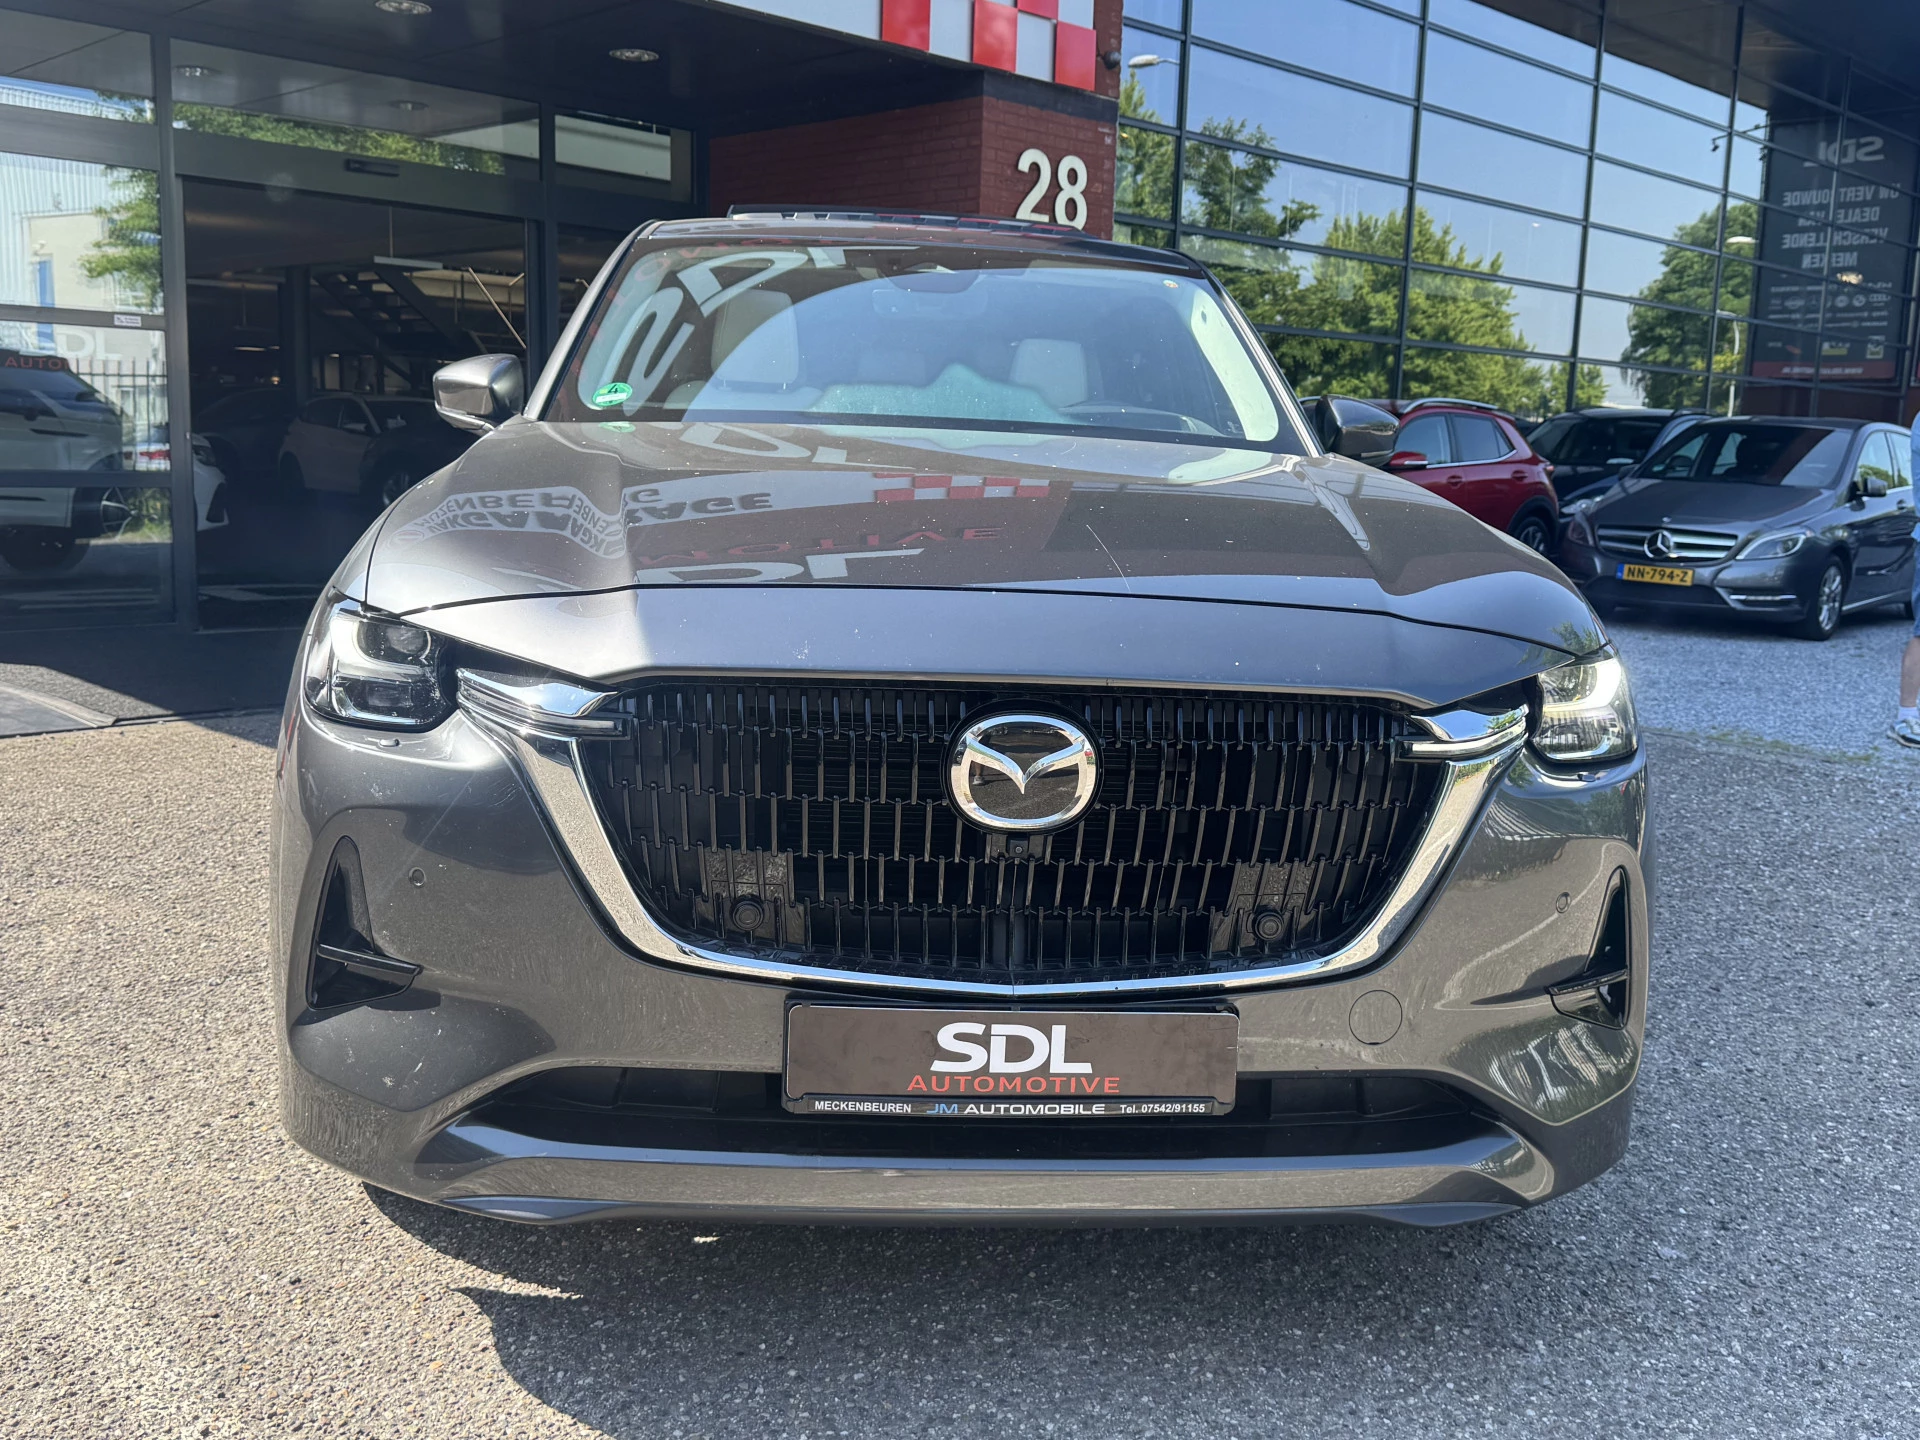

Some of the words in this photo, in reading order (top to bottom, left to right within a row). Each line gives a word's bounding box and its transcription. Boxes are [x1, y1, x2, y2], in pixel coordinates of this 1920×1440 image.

[1015, 148, 1088, 231] 28
[1626, 565, 1689, 583] NN-794-Z
[930, 1022, 1093, 1074] SDL
[907, 1075, 1121, 1094] AUTOMOTIVE
[814, 1100, 912, 1114] MECKENBEUREN
[926, 1103, 959, 1115] JM
[963, 1103, 1106, 1116] AUTOMOBILE
[1119, 1103, 1140, 1115] Tel.
[1141, 1103, 1207, 1114] 07542/91155
